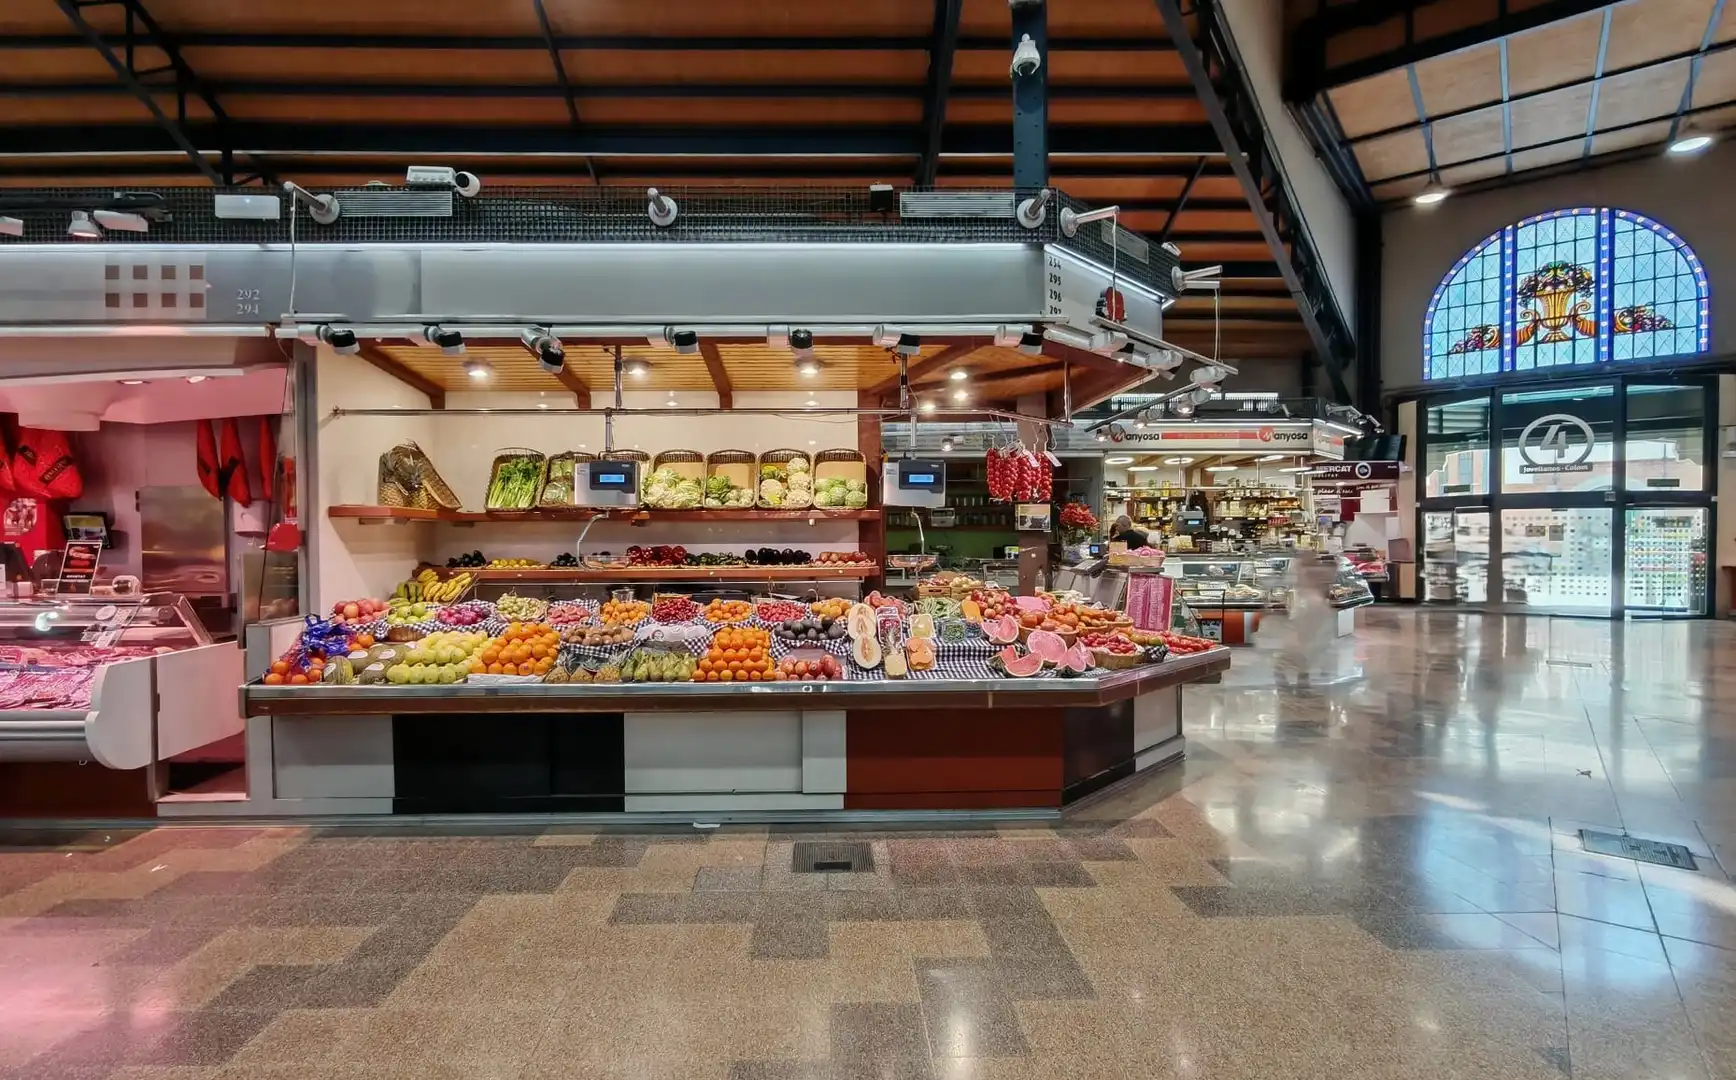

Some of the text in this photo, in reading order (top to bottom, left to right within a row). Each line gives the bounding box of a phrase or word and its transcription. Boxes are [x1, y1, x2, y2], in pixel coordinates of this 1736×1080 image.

[1049, 272, 1062, 286] 295
[236, 288, 260, 300] 292
[1049, 288, 1062, 303] 296
[236, 303, 260, 315] 294
[1540, 424, 1570, 459] 4
